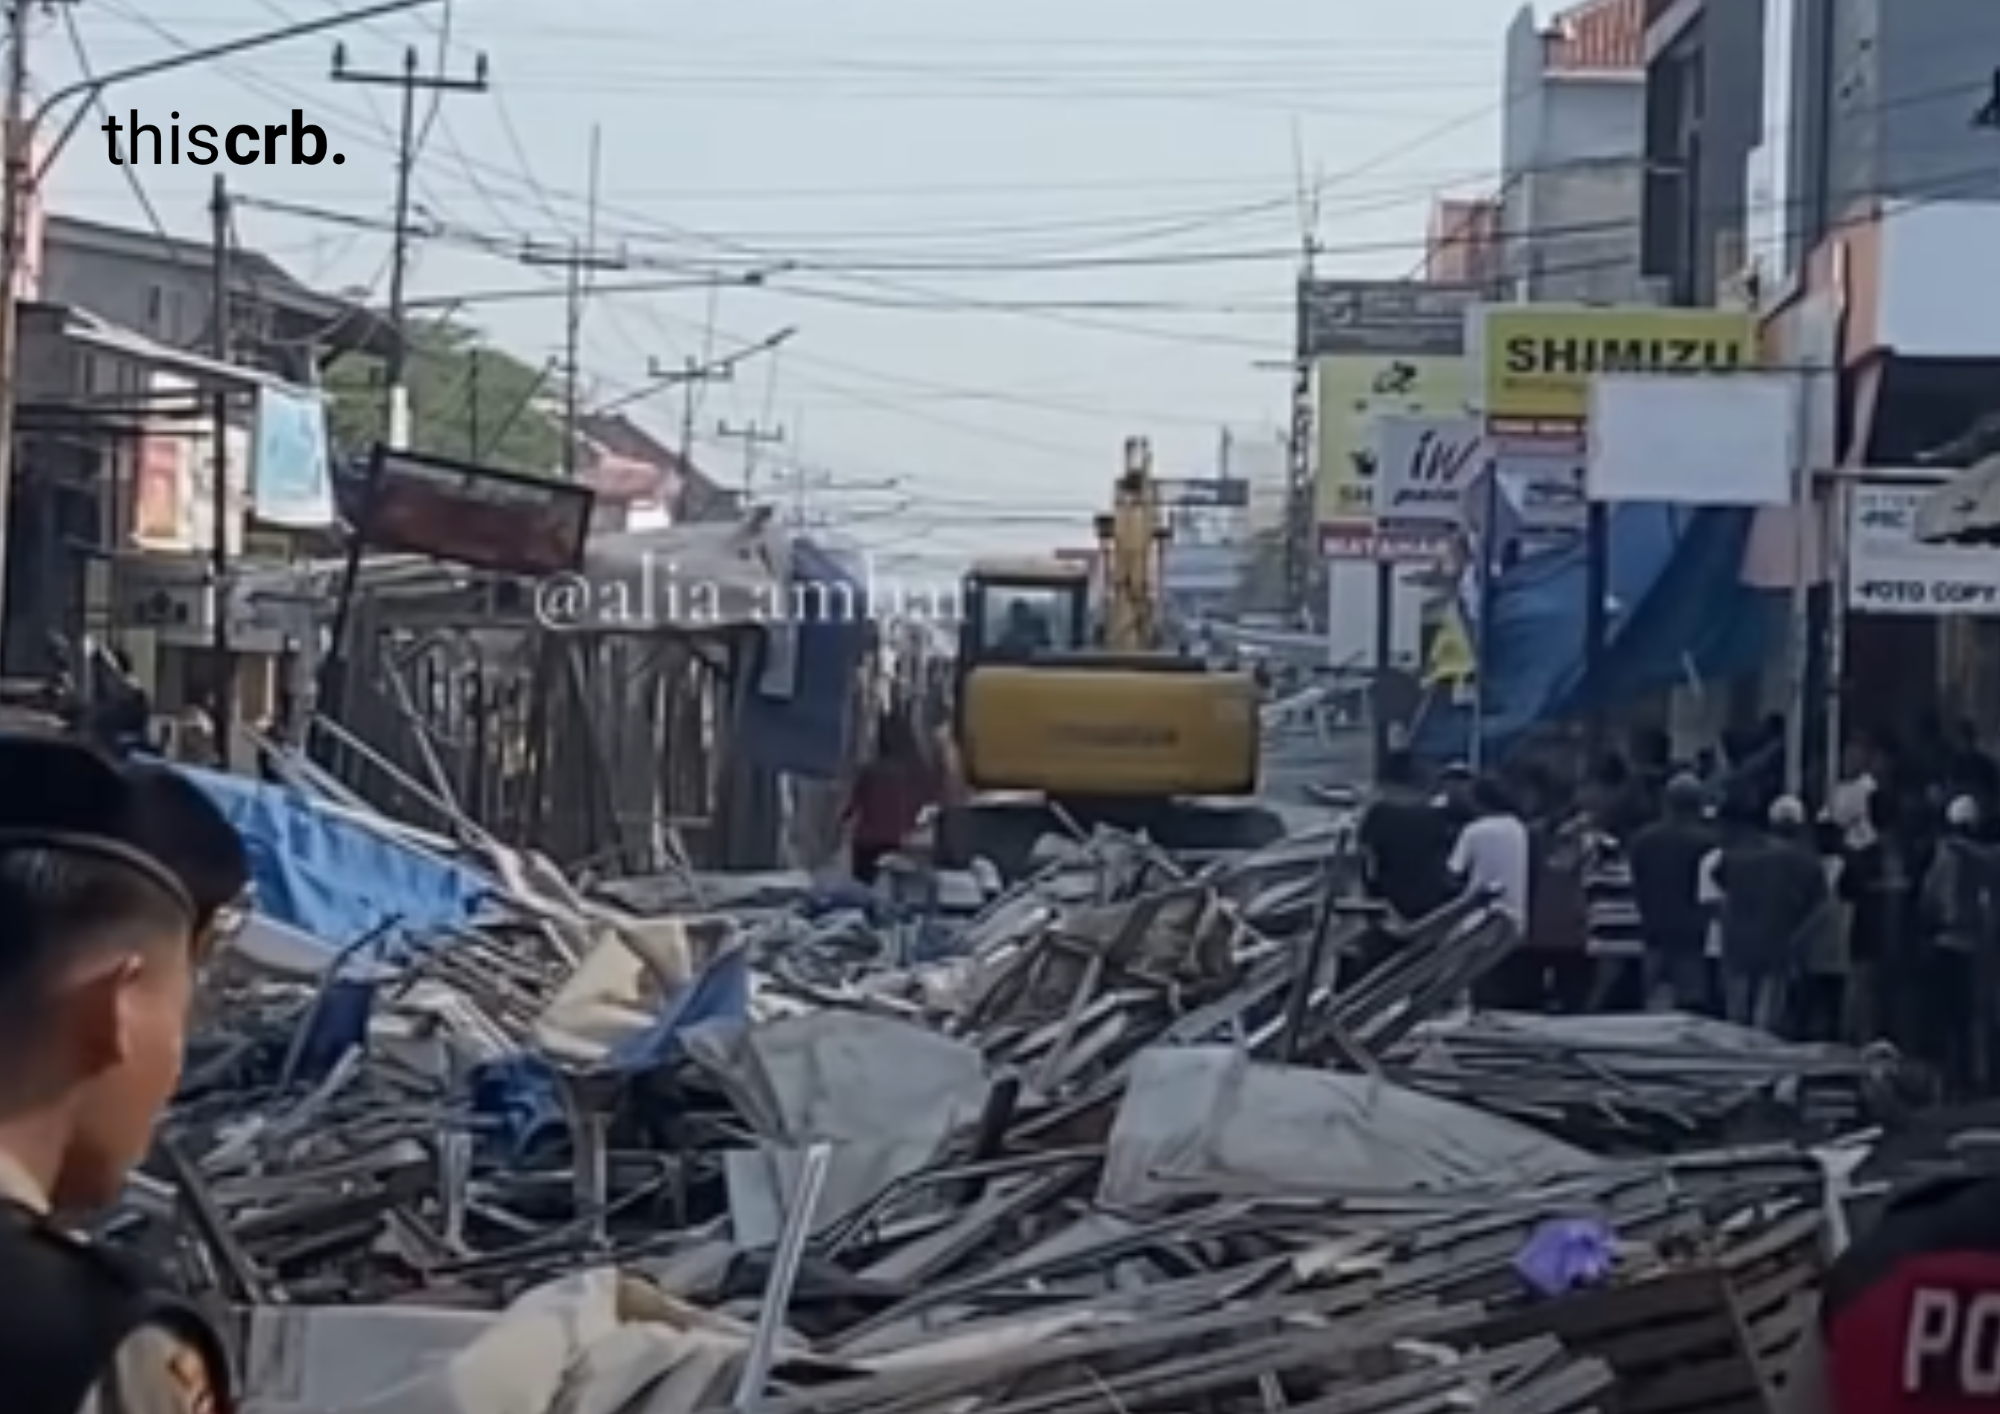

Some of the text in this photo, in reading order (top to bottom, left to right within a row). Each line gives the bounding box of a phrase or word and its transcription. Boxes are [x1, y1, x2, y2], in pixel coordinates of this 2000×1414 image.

[1506, 337, 1740, 375] SHIMIZU
[1930, 580, 1997, 604] COPY
[1902, 1286, 2000, 1394] PO
